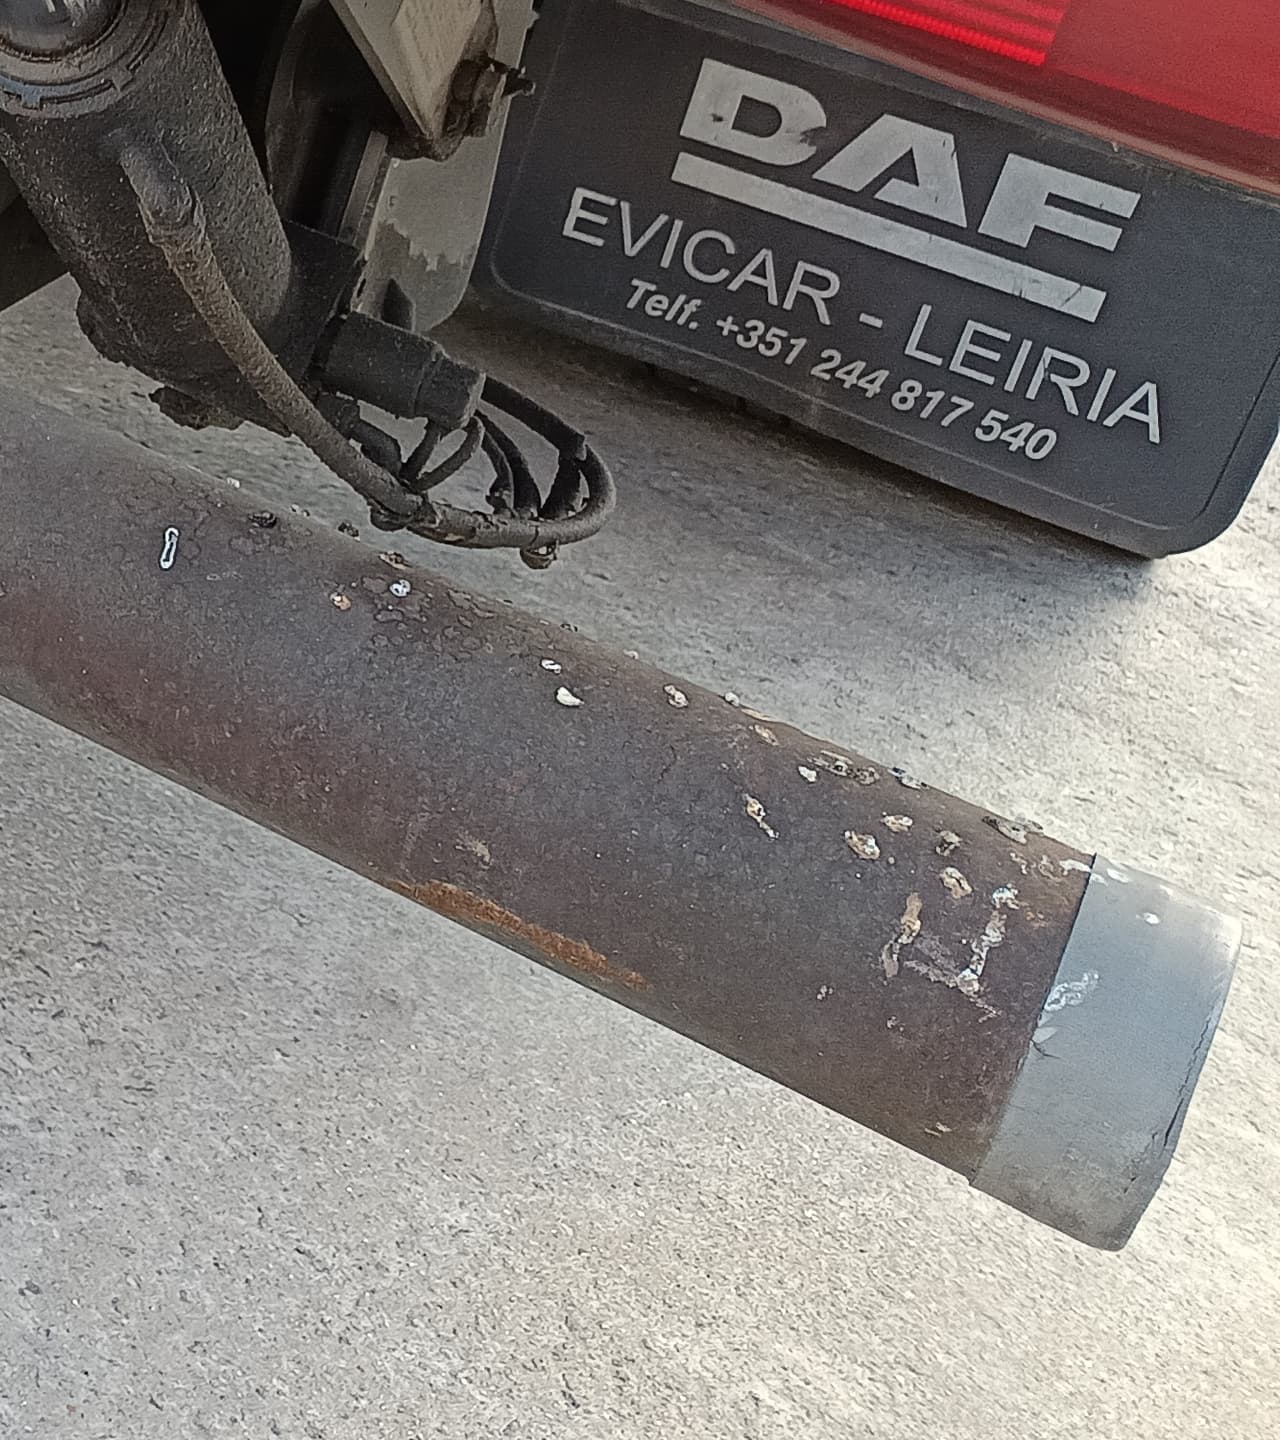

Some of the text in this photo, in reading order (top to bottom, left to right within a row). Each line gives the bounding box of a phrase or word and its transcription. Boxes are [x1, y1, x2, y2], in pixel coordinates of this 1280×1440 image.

[679, 57, 1140, 252] DAF
[561, 185, 1165, 445] EVICAR - LEIRIA
[625, 280, 1058, 461] Telf. +351 244 817 540
